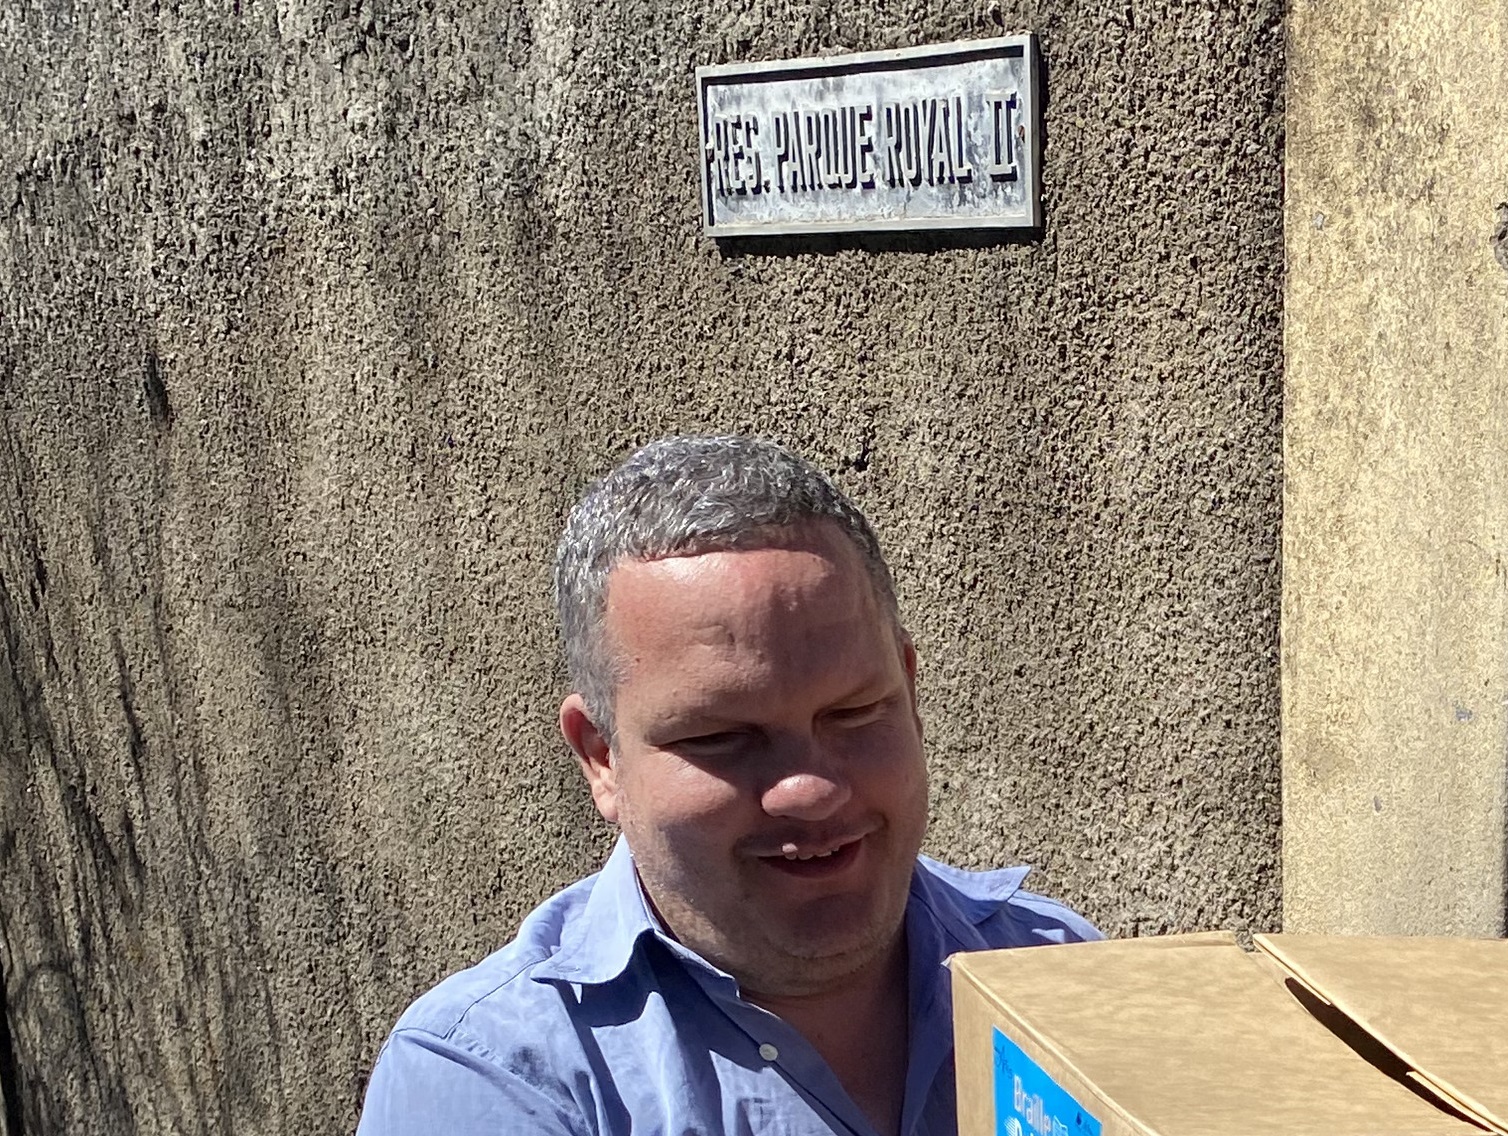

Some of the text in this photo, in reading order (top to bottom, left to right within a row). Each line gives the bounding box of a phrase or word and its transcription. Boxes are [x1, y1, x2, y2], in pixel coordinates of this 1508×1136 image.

[712, 89, 1019, 198] RES. PARQUE ROYAL II
